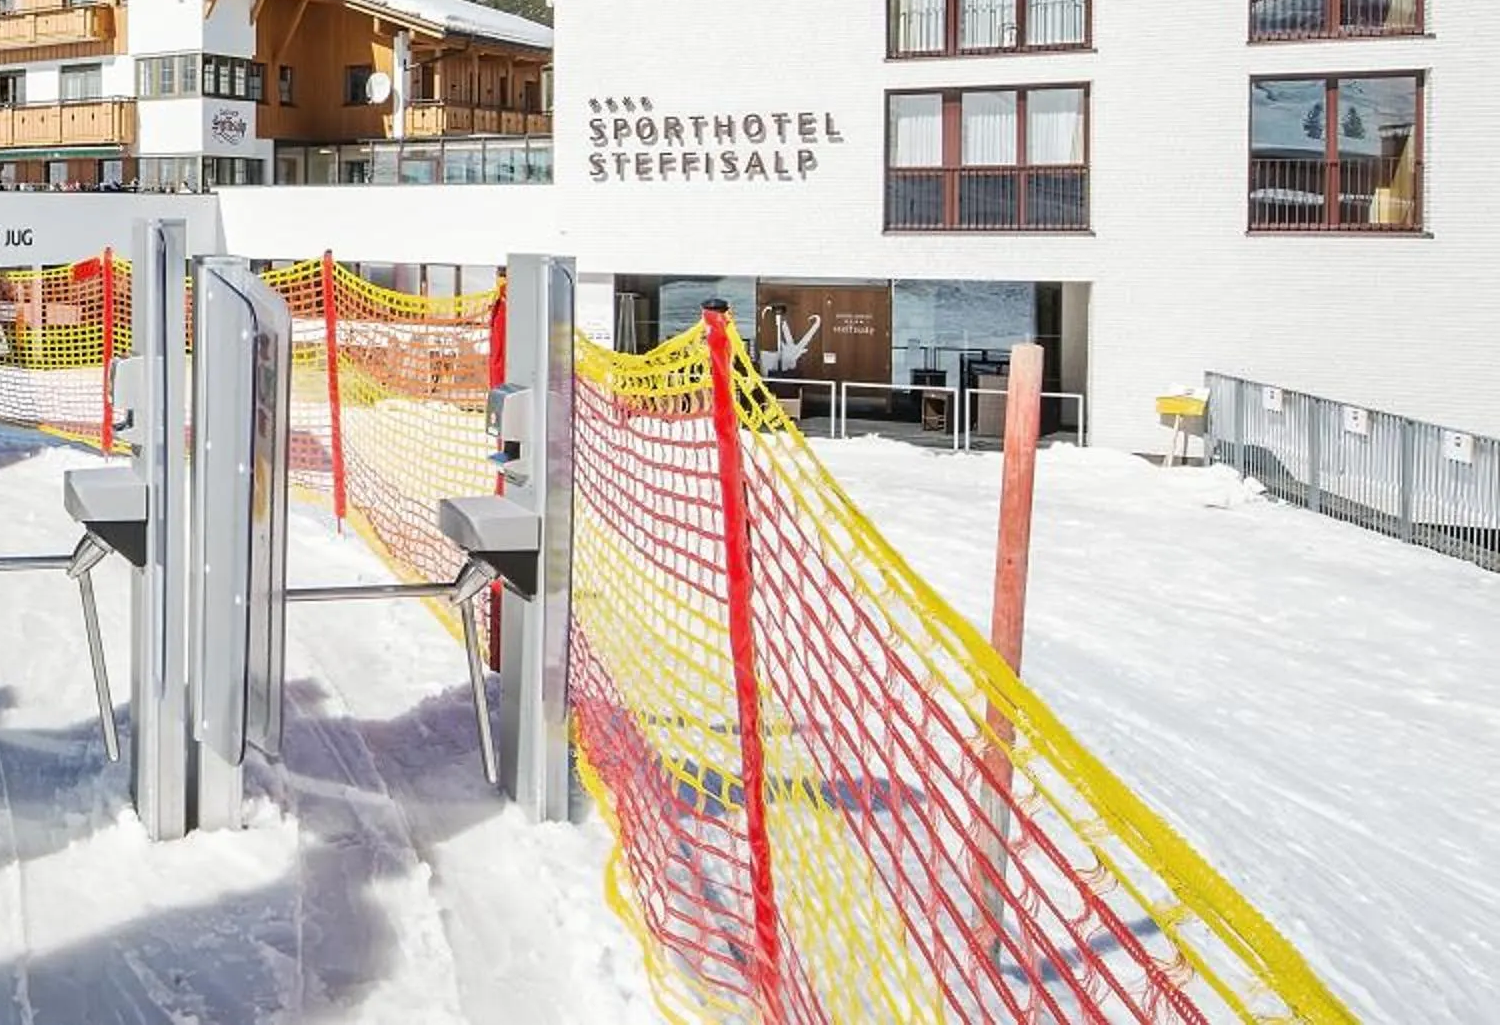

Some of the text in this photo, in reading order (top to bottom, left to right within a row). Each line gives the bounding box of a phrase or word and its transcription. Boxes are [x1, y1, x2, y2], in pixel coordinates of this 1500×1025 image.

[589, 112, 842, 145] SPORTHOTEL
[589, 150, 815, 177] STEFFISALP
[5, 229, 33, 247] JUG
